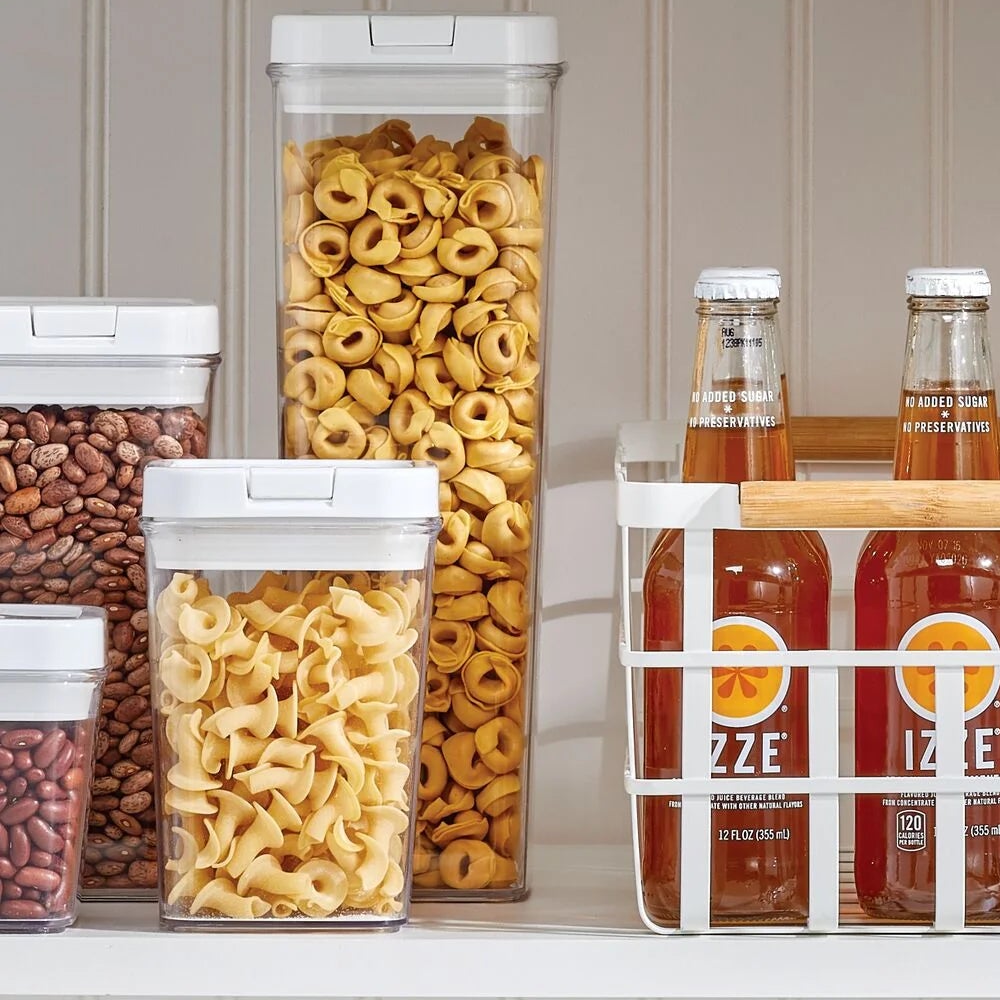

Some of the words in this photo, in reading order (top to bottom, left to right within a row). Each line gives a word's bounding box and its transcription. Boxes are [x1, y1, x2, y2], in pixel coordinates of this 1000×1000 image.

[702, 391, 736, 403] ADDED
[741, 390, 774, 402] SUGAR
[905, 396, 915, 408] NO
[917, 396, 953, 408] ADDED
[957, 395, 988, 408] SUGAR
[699, 416, 776, 428] PRESERVATIVES
[903, 421, 912, 433] NO
[914, 421, 990, 433] PRESERVATIVES
[711, 732, 782, 774] ZZE
[905, 728, 995, 771] IZE
[722, 802, 737, 810] WITH
[738, 802, 758, 810] OTHER
[758, 801, 782, 809] NATURAL
[783, 800, 803, 808] FLAVORS
[896, 799, 935, 807] CONCENTRATE
[973, 797, 997, 805] NATURAL
[900, 814, 922, 831] 120
[719, 829, 729, 841] 12
[731, 829, 742, 840] FL
[741, 829, 754, 840] OZ
[755, 829, 774, 841] (355
[775, 828, 790, 840] mL)
[898, 831, 925, 839] CALORIES
[970, 825, 989, 837] (355
